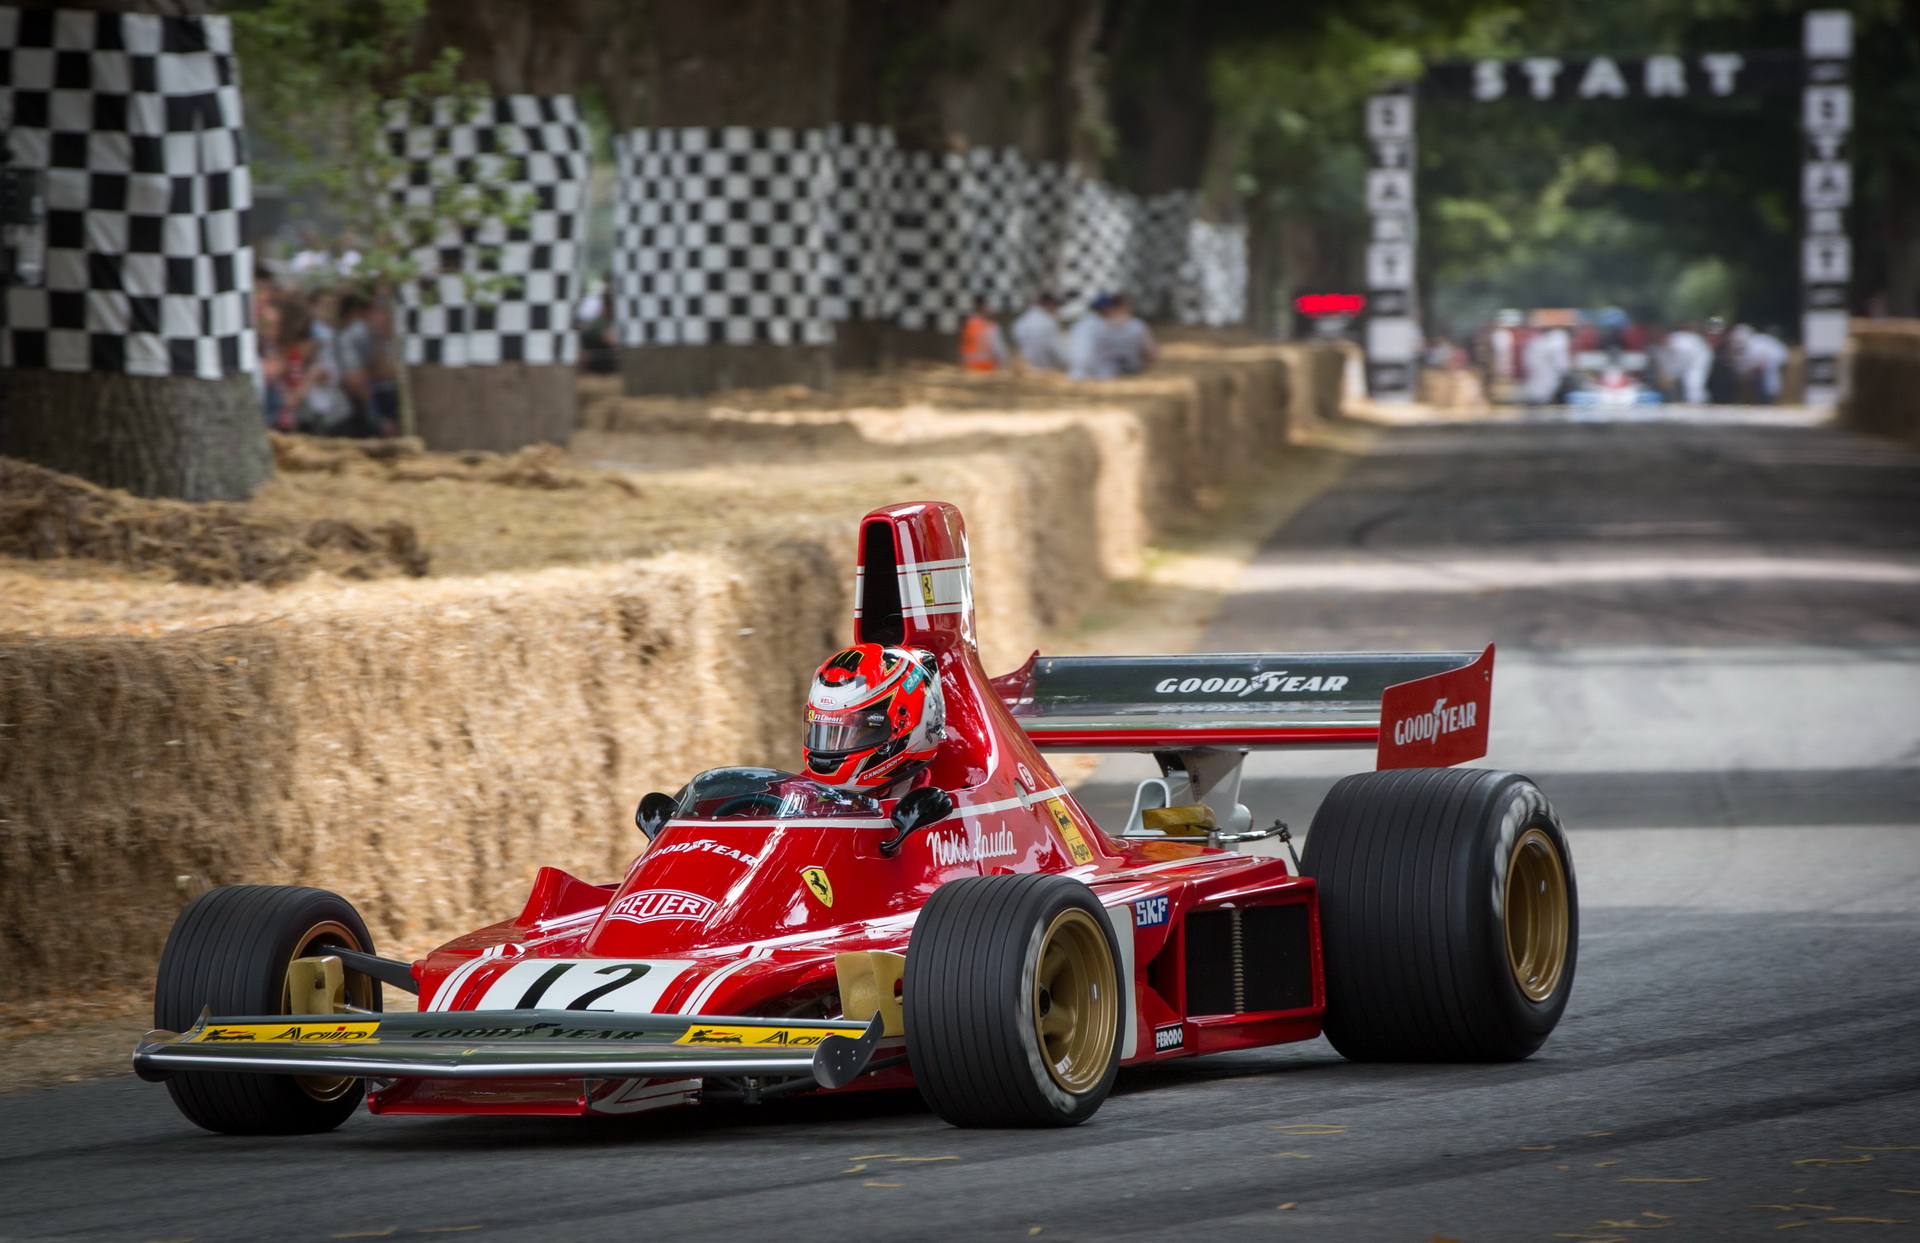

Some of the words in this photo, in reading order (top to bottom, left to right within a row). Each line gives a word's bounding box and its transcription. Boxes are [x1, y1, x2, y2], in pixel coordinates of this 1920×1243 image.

[1472, 54, 1744, 98] START
[926, 829, 970, 867] Niki
[972, 820, 1017, 860] Lauda
[1070, 841, 1091, 861] Agip
[615, 894, 701, 918] HEUER
[1136, 898, 1168, 926] SKF
[514, 963, 652, 1012] 12
[1156, 1028, 1183, 1048] FERODO
